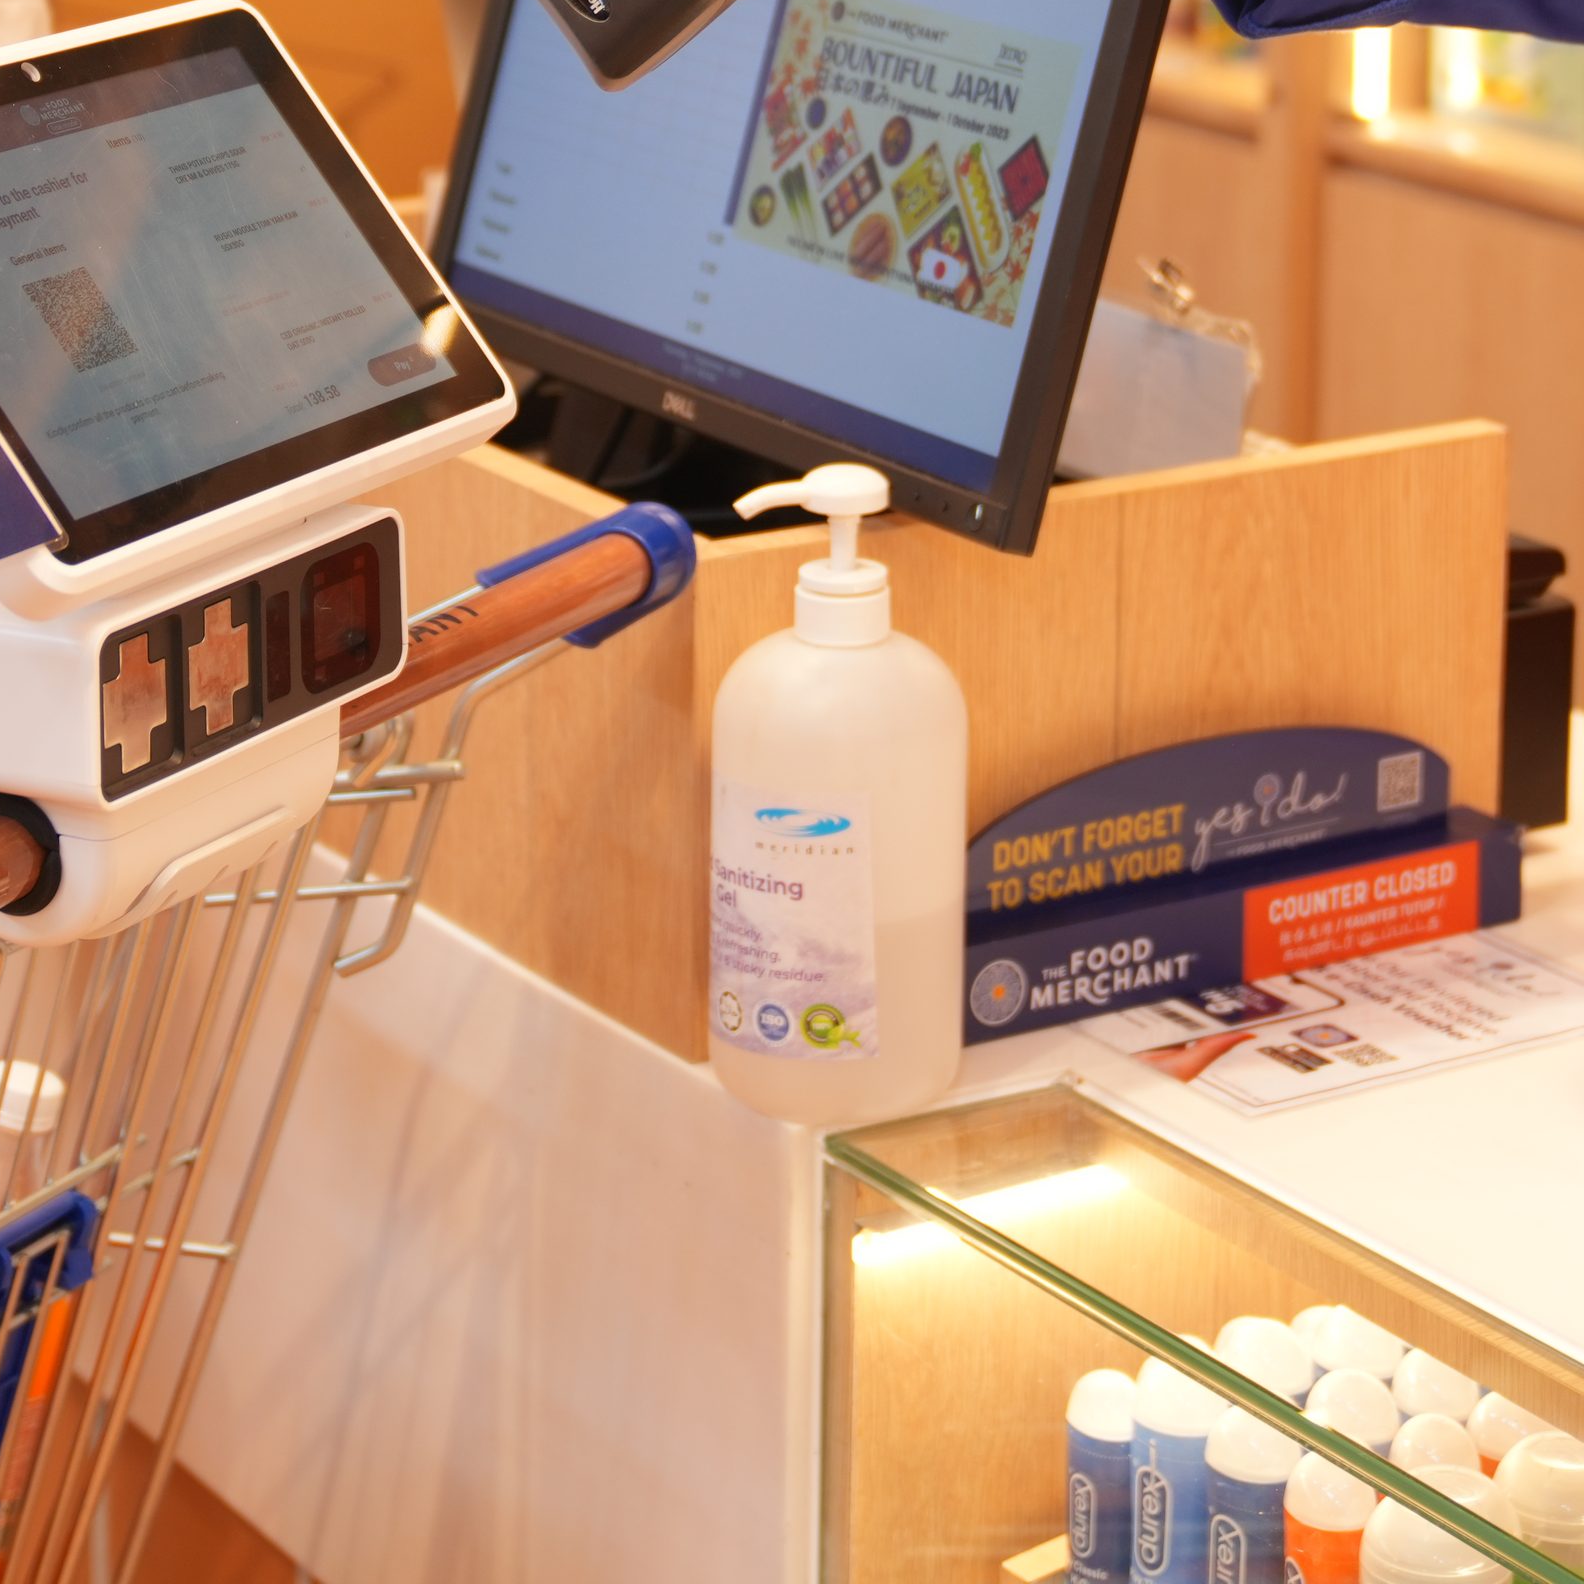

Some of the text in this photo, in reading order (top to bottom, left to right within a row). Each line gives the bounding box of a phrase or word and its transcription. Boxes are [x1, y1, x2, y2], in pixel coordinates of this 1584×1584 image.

[817, 37, 1018, 113] BOUNTIFUL JAPAN
[105, 136, 131, 148] Items
[9, 187, 31, 201] the
[30, 177, 71, 196] cashier
[69, 171, 88, 184] for
[9, 243, 67, 266] General items
[303, 384, 340, 406] 138.58
[754, 840, 855, 856] meridian
[992, 804, 1187, 873] DON'T FORGET
[986, 842, 1185, 912] TO SCAN YOUR
[1268, 860, 1457, 925] COUNTER CLOSED
[1028, 954, 1192, 1012] MERCHANT
[1041, 936, 1154, 981] THE FOOD
[1072, 1478, 1092, 1549] durex
[1137, 1469, 1166, 1565] durex
